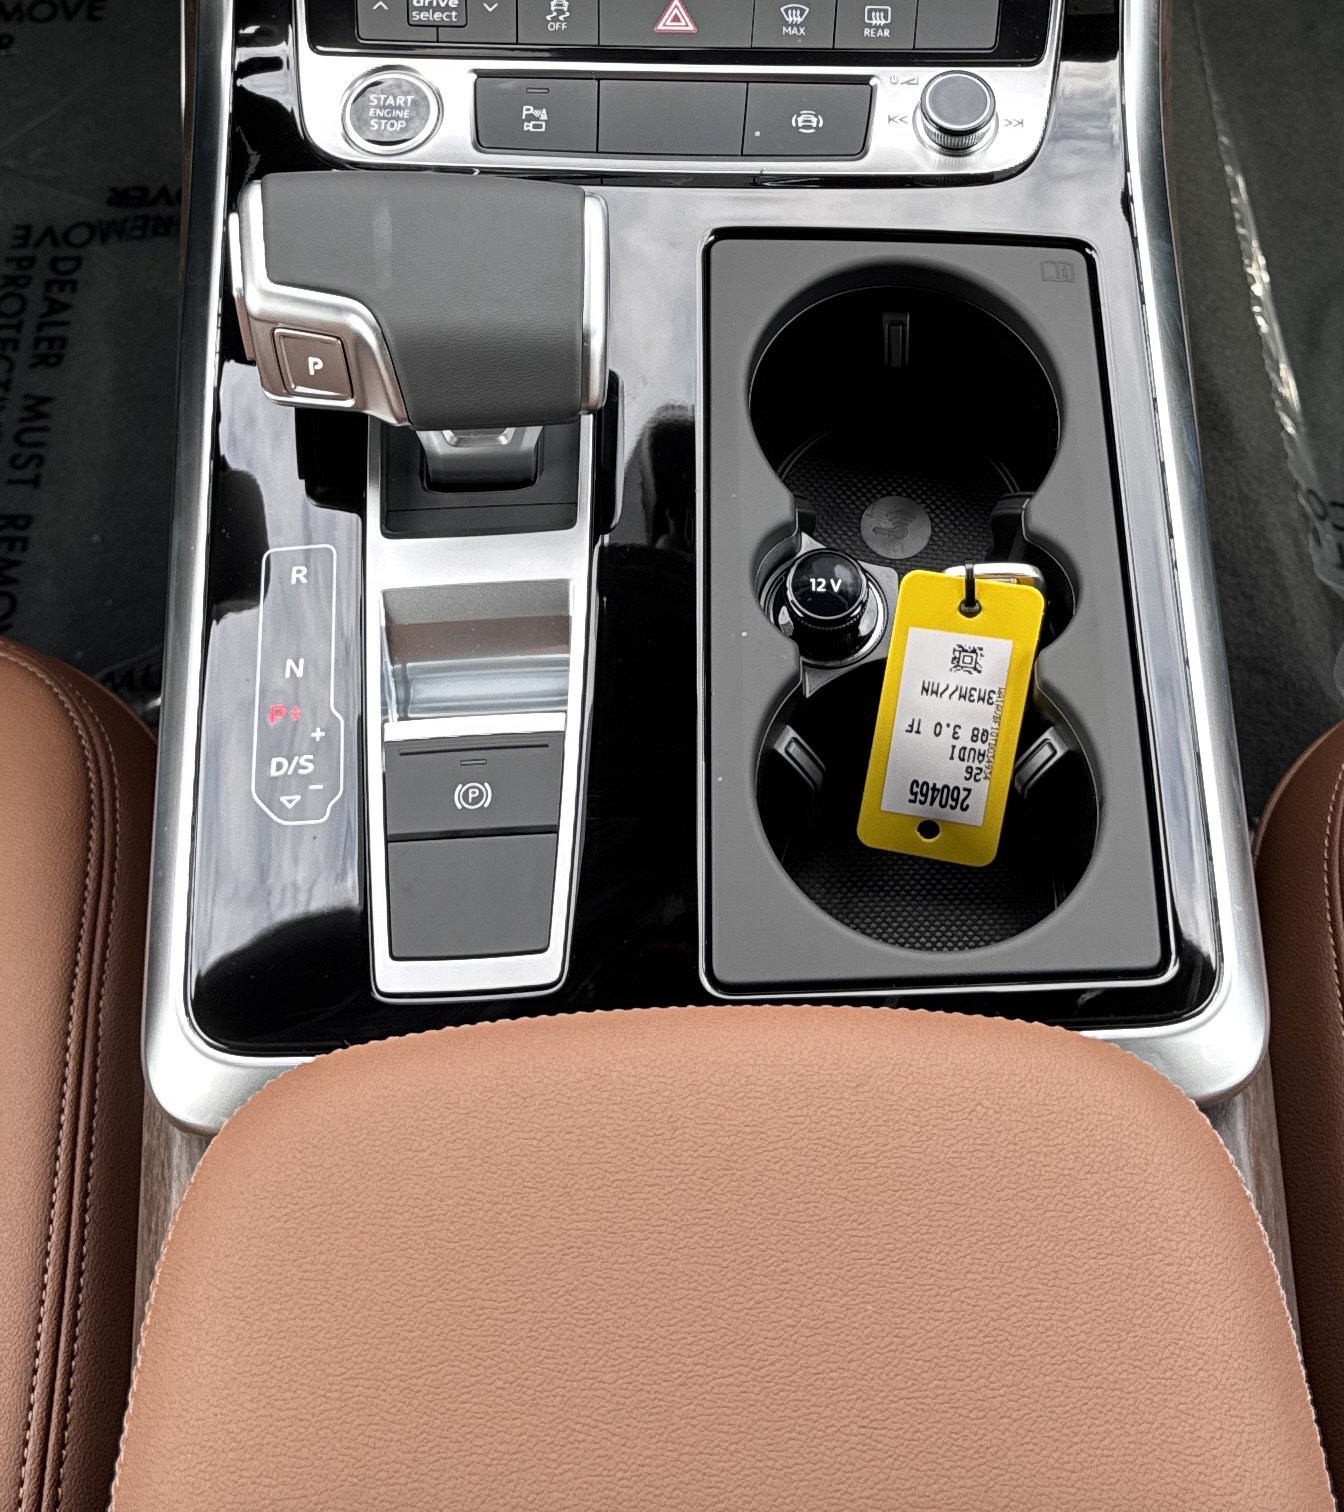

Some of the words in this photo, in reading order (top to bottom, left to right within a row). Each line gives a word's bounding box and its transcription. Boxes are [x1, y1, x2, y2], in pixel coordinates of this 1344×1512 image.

[411, 9, 458, 21] select
[547, 22, 567, 31] OFF
[782, 26, 806, 36] MAX
[864, 28, 890, 37] REAR
[369, 94, 414, 107] START
[369, 108, 410, 119] ENGINE
[370, 119, 407, 131] STOP
[10, 210, 182, 251] REMOVE
[28, 254, 83, 371] DEALER
[308, 355, 324, 376] P
[6, 393, 53, 489] MUST
[290, 566, 308, 585] R
[810, 578, 827, 592] 12
[830, 578, 842, 591] V
[284, 659, 304, 678] N
[905, 718, 922, 734] TF
[933, 722, 961, 740] 3.0
[971, 727, 988, 744] Q8
[949, 745, 986, 764] AUDI
[269, 755, 315, 777] D/S
[964, 766, 983, 782] 26
[909, 779, 972, 812] 260465
